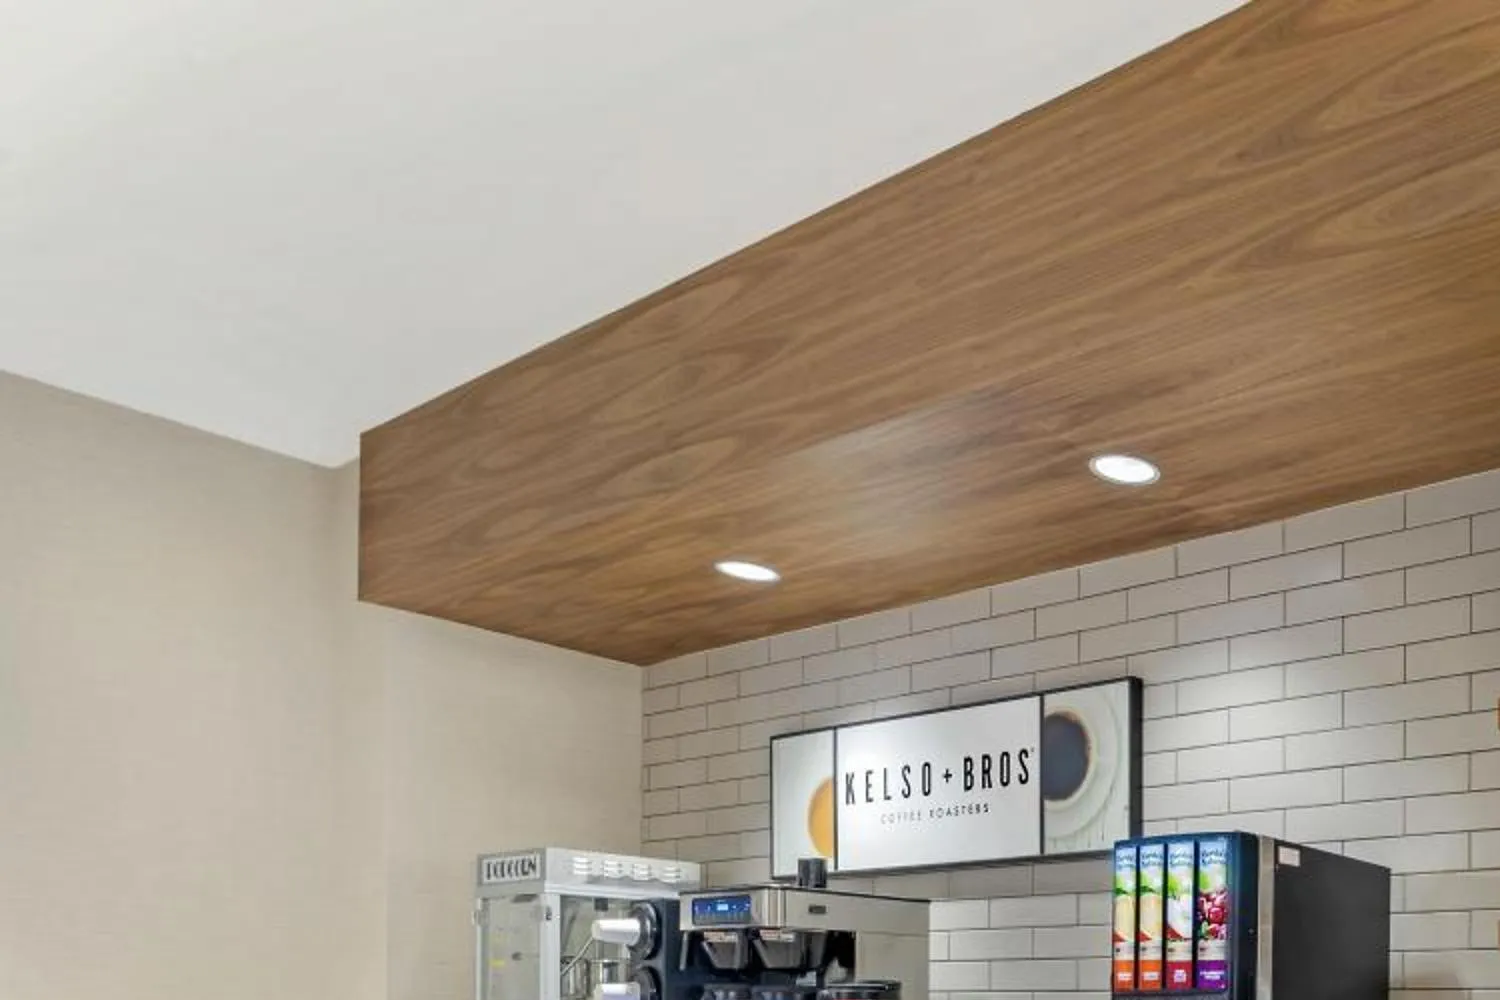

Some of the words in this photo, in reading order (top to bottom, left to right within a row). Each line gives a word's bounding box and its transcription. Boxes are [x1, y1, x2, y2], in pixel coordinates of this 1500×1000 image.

[845, 762, 932, 805] KELSO
[963, 748, 1030, 792] BROS
[881, 811, 922, 825] COFFEE
[929, 803, 989, 820] ROASTERS
